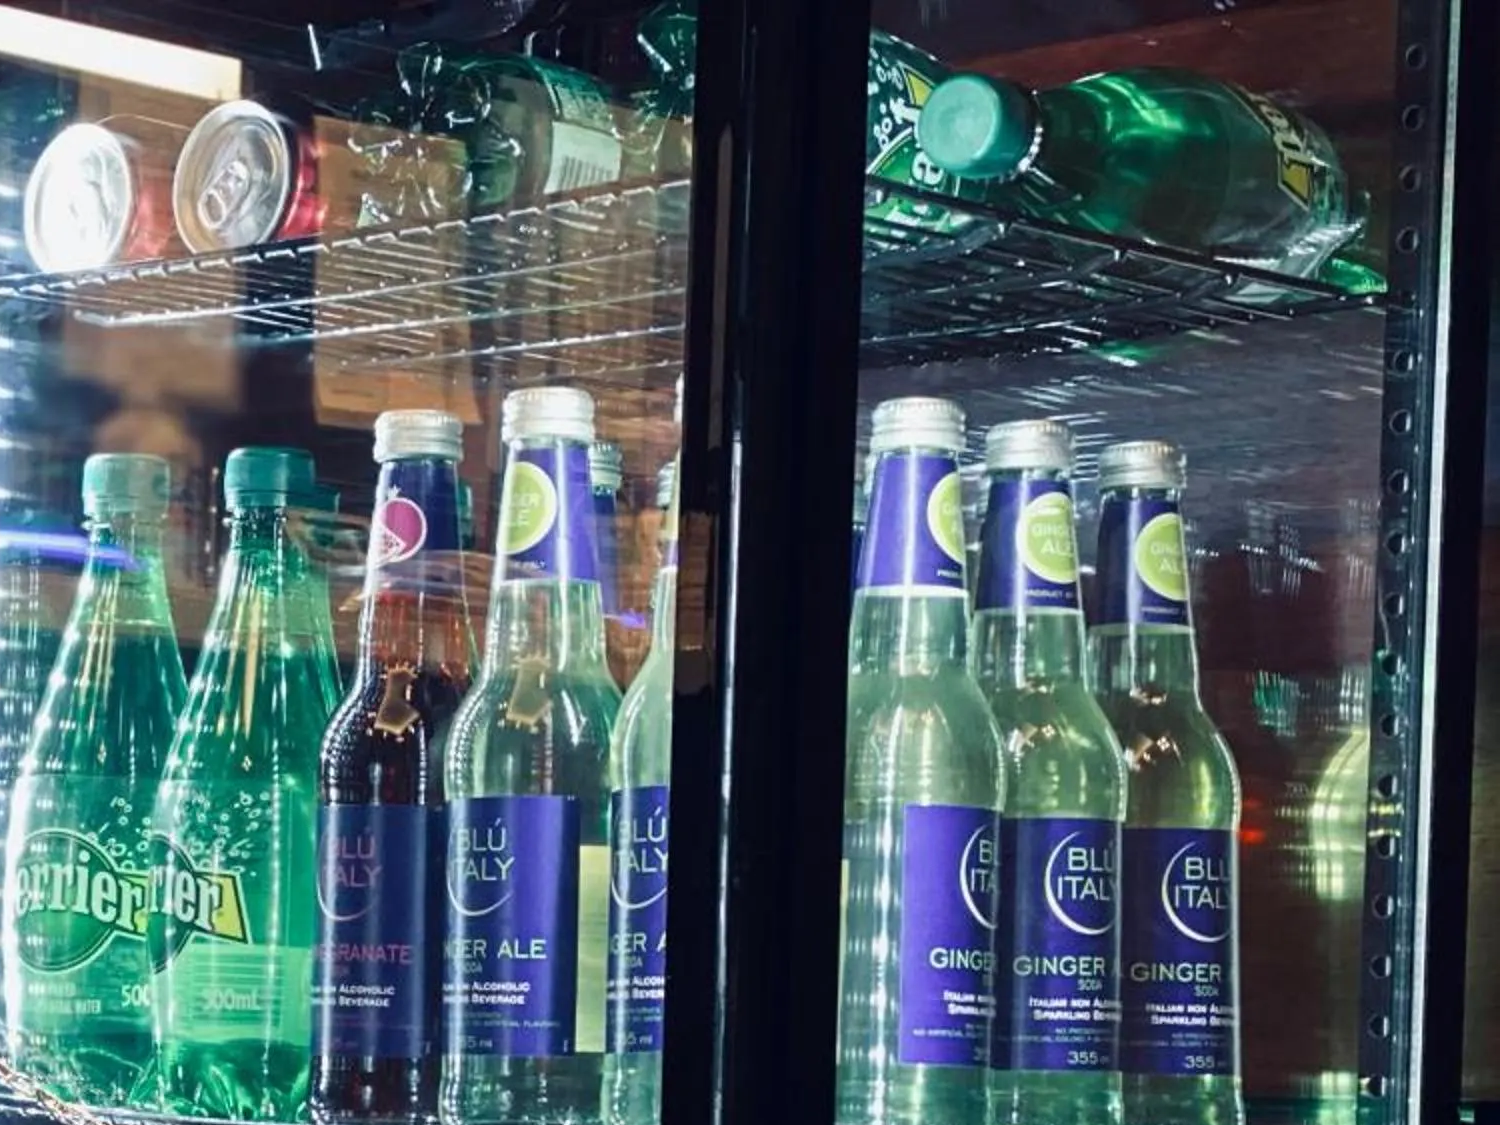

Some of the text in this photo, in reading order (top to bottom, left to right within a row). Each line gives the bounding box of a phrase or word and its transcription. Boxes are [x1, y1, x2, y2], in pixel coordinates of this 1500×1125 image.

[15, 849, 149, 932] errier
[497, 938, 547, 959] ALE
[929, 948, 997, 971] GINGE
[1013, 955, 1106, 977] GINGER
[1130, 962, 1221, 983] GINGER
